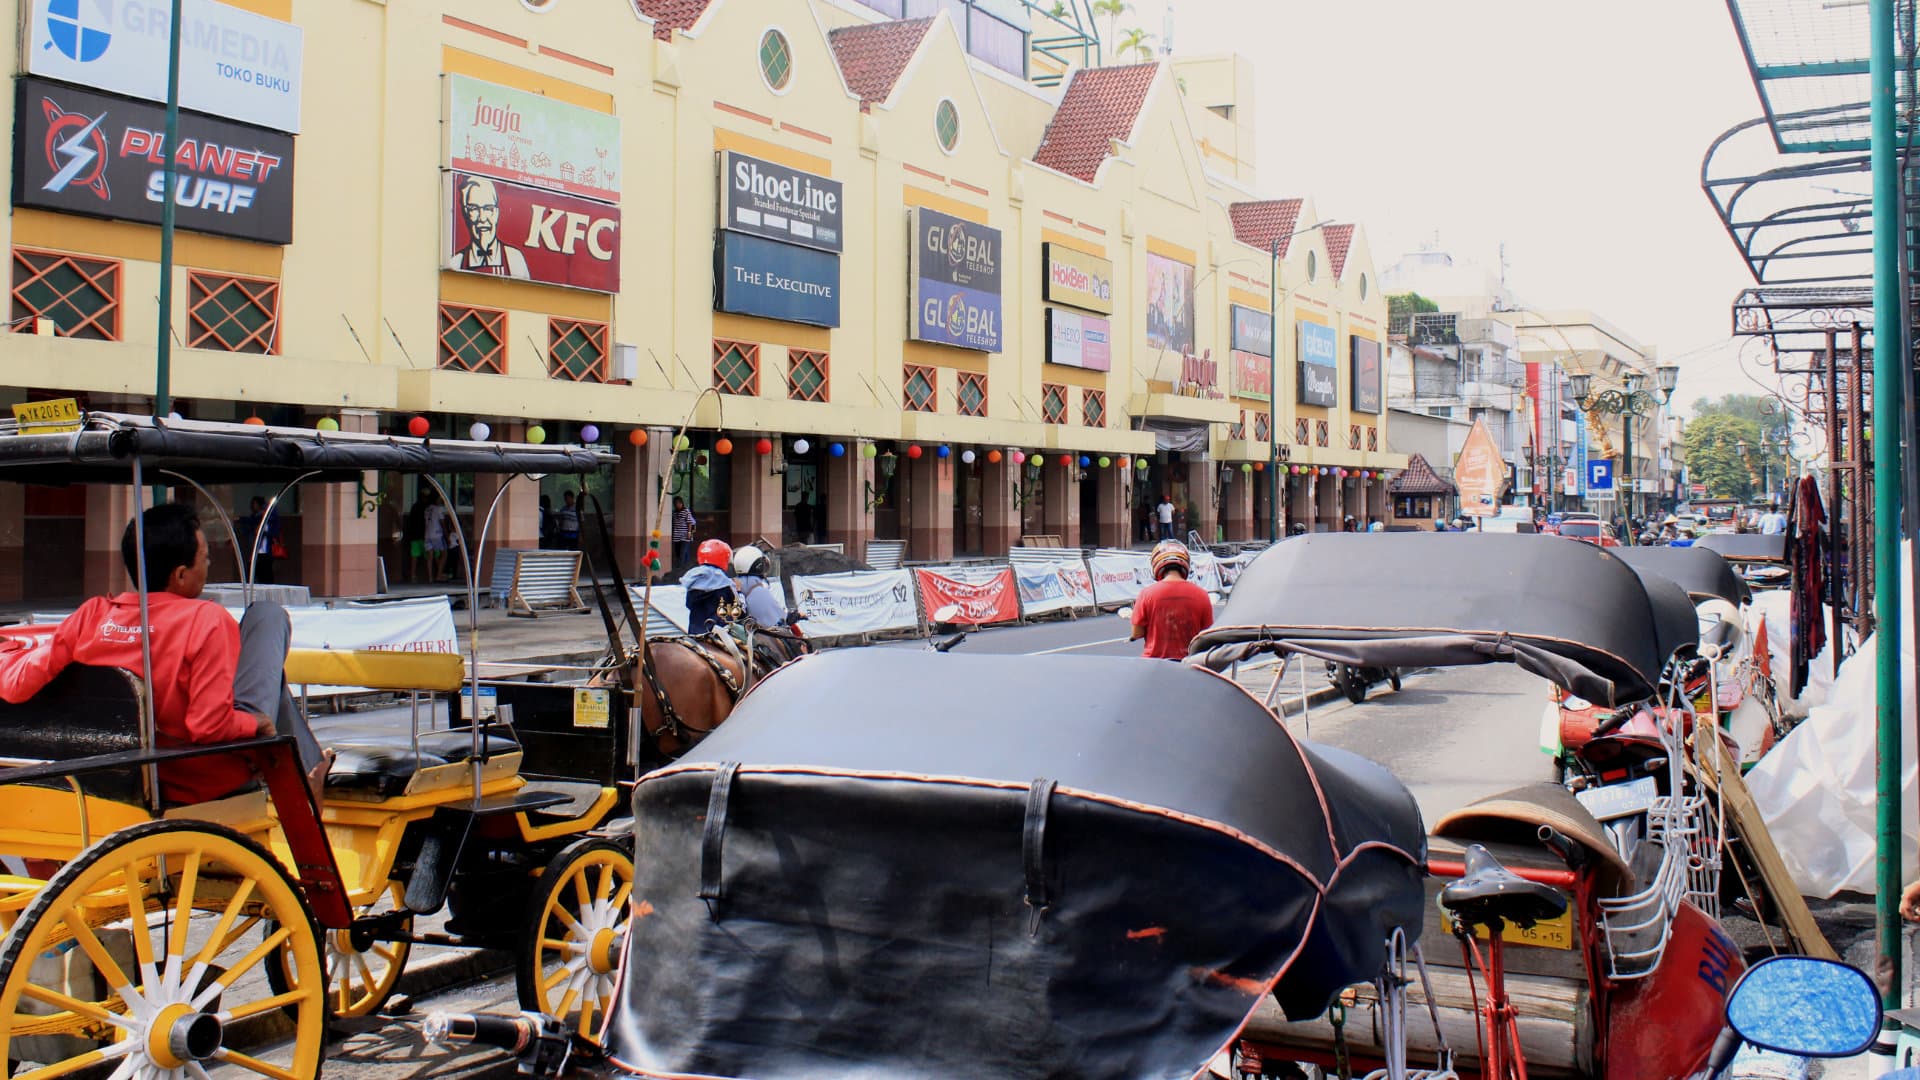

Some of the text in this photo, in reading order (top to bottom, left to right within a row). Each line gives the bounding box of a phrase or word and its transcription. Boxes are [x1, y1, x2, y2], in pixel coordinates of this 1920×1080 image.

[215, 61, 291, 94] TOKO BUKU
[472, 95, 521, 134] jogja
[119, 127, 282, 184] PLANET
[146, 170, 256, 215] SURF
[735, 160, 837, 215] ShoeLine
[523, 203, 617, 261] KFC
[1052, 262, 1089, 293] HokBen
[1592, 465, 1607, 484] P
